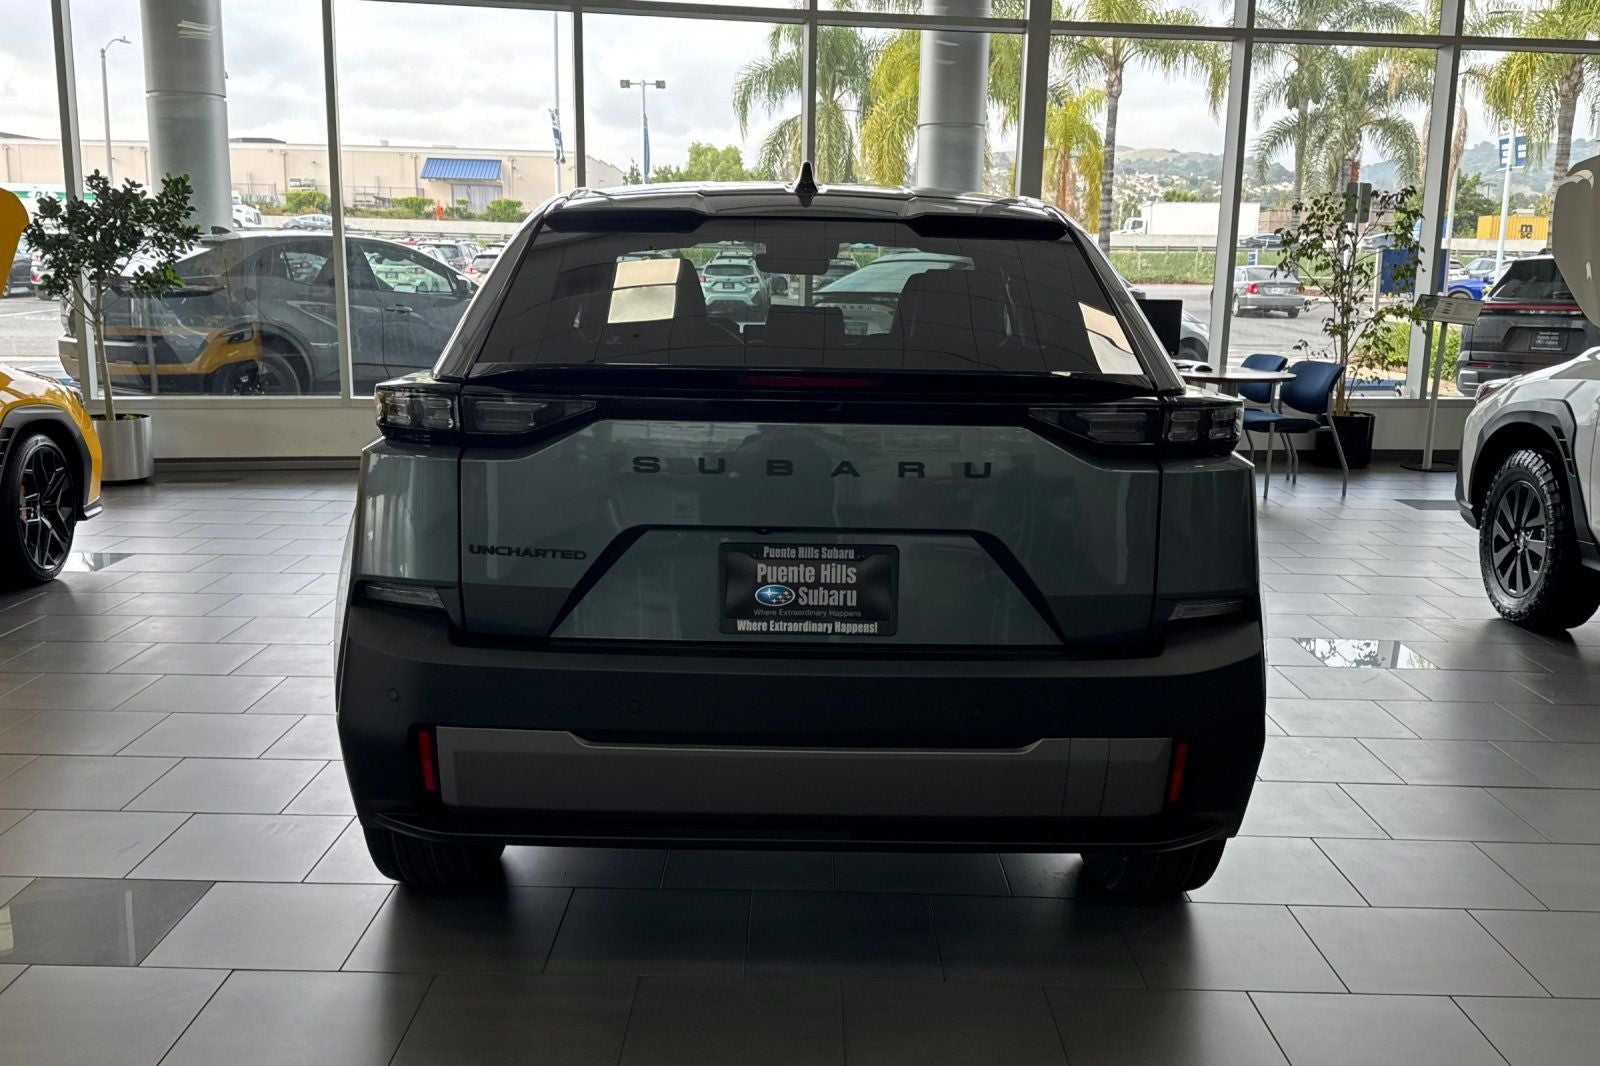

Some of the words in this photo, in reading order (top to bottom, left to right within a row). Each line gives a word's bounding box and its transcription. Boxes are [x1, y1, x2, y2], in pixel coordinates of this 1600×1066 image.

[632, 456, 992, 480] SUBARU
[468, 544, 588, 560] UNCHARTED
[763, 546, 796, 559] Puente
[798, 546, 820, 559] Hills
[821, 546, 855, 560] Subaru
[757, 563, 815, 584] Puente
[820, 563, 857, 584] Hills
[798, 586, 857, 607] Subaru
[753, 608, 777, 616] Where
[778, 608, 827, 618] Extraordinary
[829, 609, 862, 619] Happens
[736, 619, 767, 632] Where
[769, 620, 833, 634] Extraordinary
[834, 621, 878, 634] Happens!
